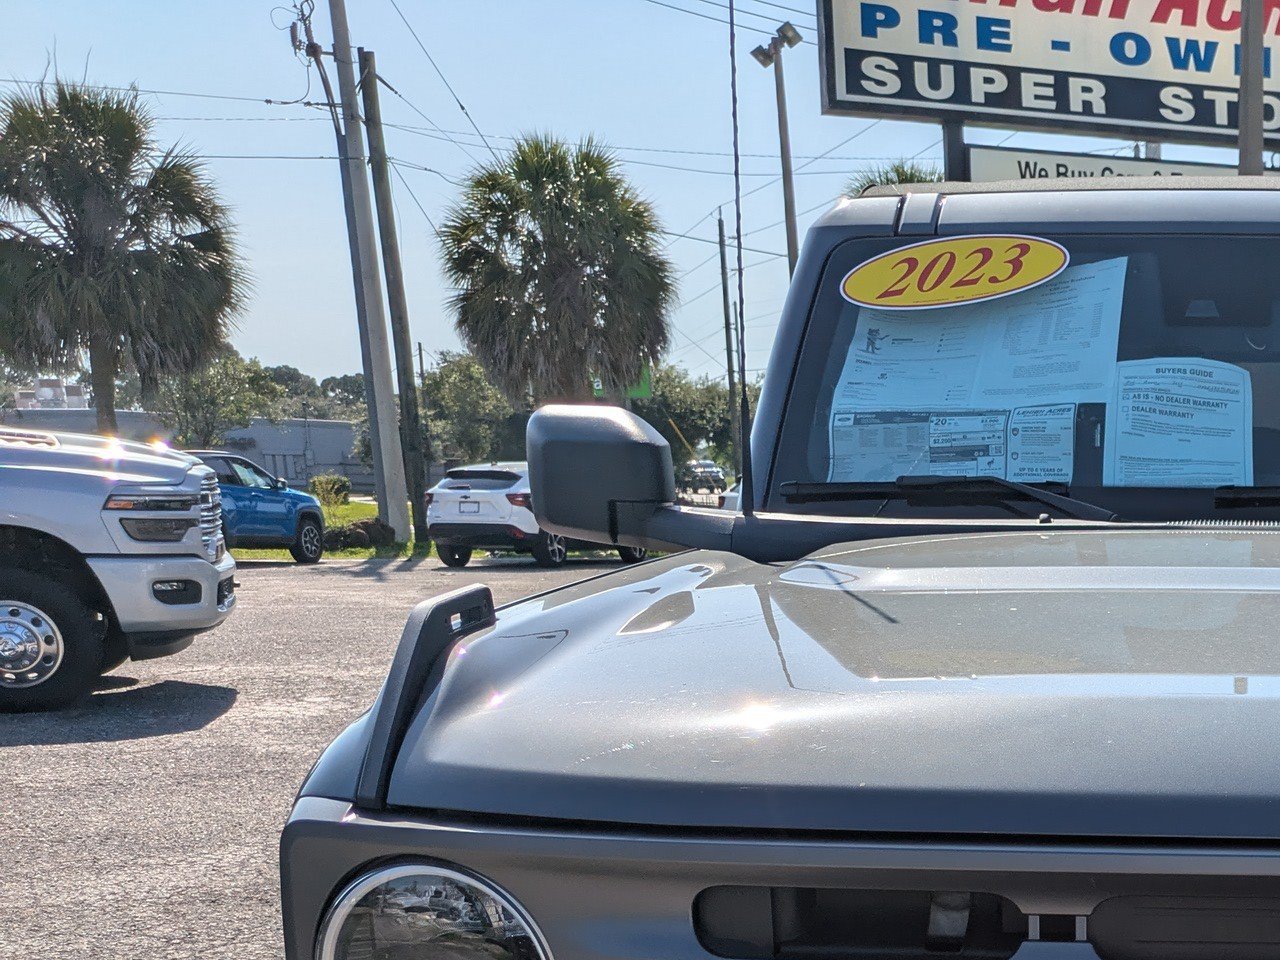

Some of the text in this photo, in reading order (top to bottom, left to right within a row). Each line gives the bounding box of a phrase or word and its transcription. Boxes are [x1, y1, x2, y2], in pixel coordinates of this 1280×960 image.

[860, 2, 1013, 53] PRE
[860, 56, 1106, 115] SUPER
[1017, 160, 1049, 179] We
[875, 243, 1031, 300] 2023
[1155, 367, 1214, 378] BUYERS GUIDE
[1166, 396, 1191, 406] DEALER
[1192, 399, 1228, 409] WARRANTY
[1131, 406, 1157, 414] DEALER
[1158, 409, 1195, 419] WARRANTY
[934, 418, 947, 426] 20
